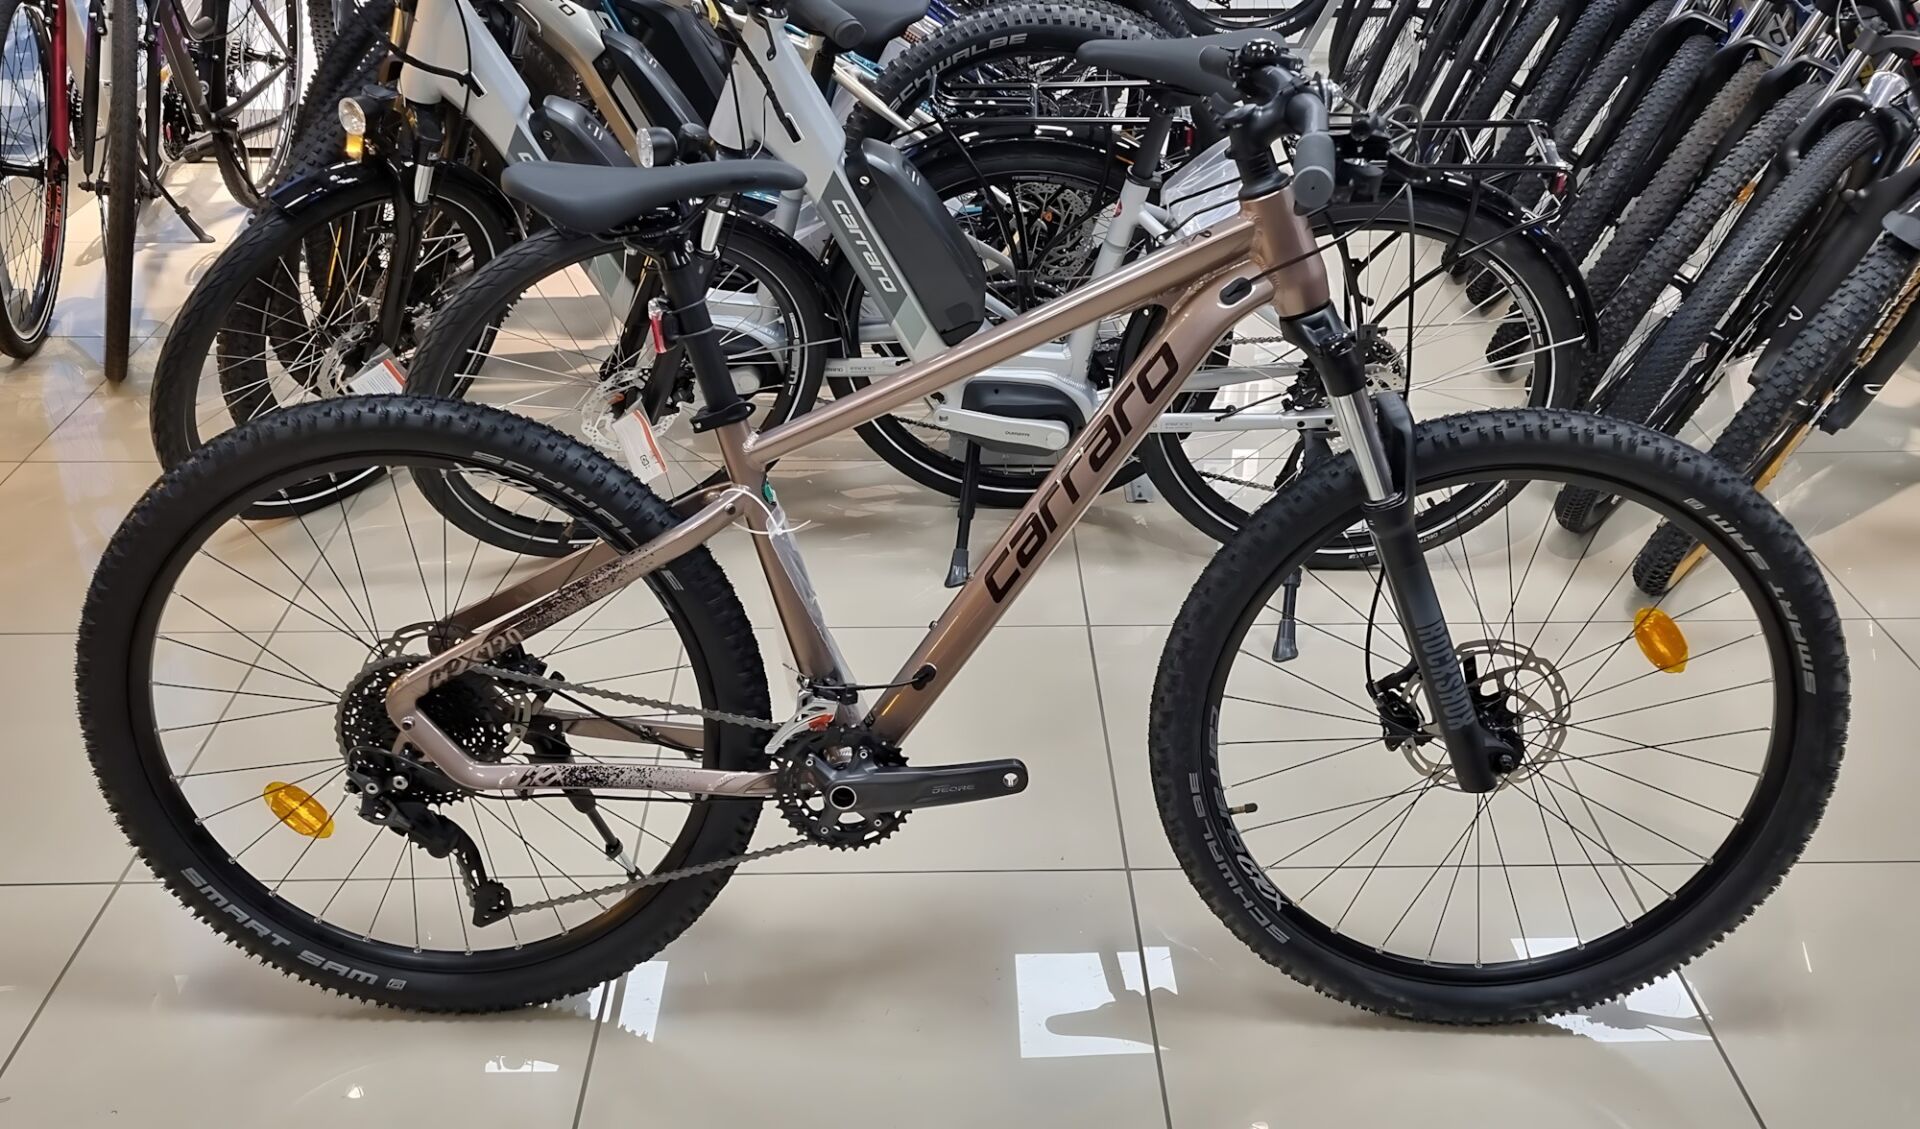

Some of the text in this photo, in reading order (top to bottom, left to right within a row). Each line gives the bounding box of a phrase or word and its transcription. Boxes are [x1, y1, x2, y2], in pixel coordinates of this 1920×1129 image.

[888, 32, 1028, 112] SCHWALBE
[831, 199, 898, 293] carraro
[471, 450, 685, 592] SCHWALE
[984, 341, 1179, 604] carraro
[1707, 513, 1817, 695] SMART SAM
[1416, 618, 1475, 731] ROCKSHOX
[1188, 771, 1291, 945] SCHWALBE
[180, 866, 379, 986] SMART SAM
